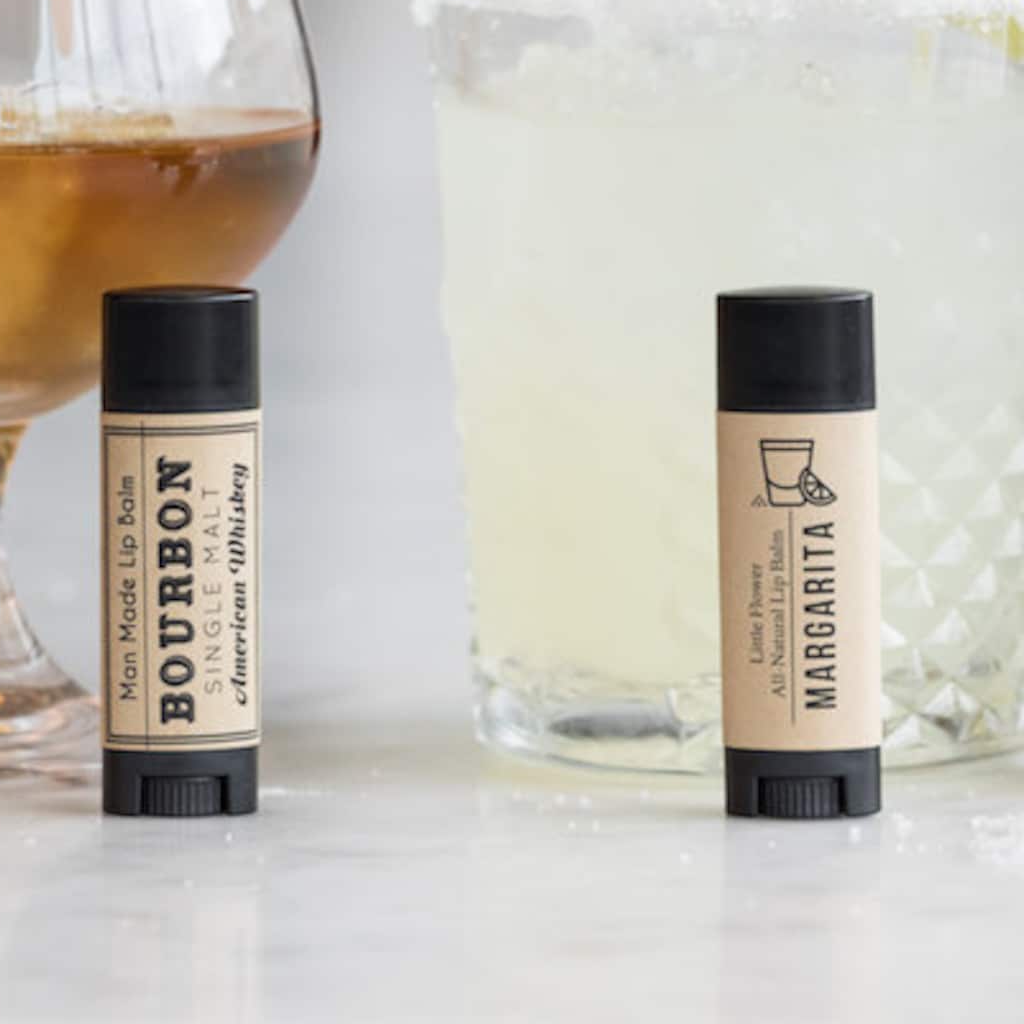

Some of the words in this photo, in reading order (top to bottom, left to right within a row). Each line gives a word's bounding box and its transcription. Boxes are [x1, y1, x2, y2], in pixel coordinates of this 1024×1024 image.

[117, 476, 136, 526] Balm
[202, 488, 221, 564] MALT
[228, 463, 249, 574] Whiskey
[118, 534, 138, 568] Lip
[770, 529, 785, 572] Balm
[118, 578, 137, 643] Made
[157, 456, 195, 725] BOURBON
[749, 563, 764, 618] Flower
[771, 575, 790, 603] Lip
[802, 522, 836, 710] MARGARITA
[203, 582, 223, 694] SINGLE
[230, 581, 248, 707] American
[749, 621, 764, 664] Little
[771, 607, 786, 698] All-Natural
[119, 651, 137, 701] Man
